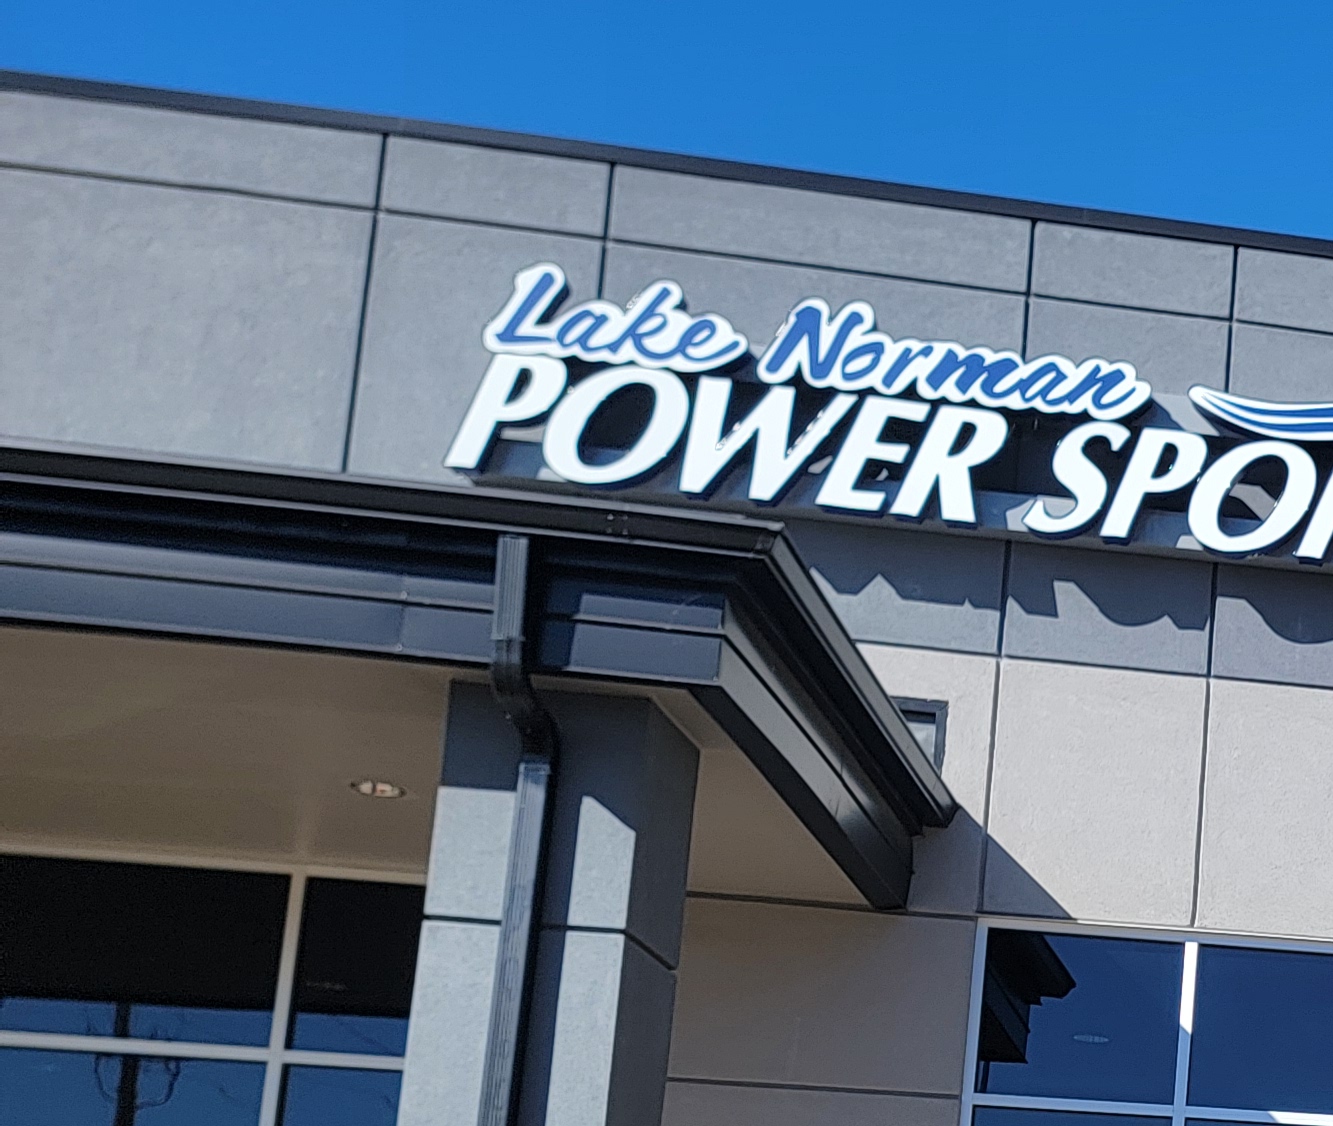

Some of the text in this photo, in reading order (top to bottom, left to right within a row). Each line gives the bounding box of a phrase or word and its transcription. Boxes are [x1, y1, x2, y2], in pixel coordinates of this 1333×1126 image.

[488, 265, 1150, 417] Lake Norman
[443, 353, 1009, 528] POWER
